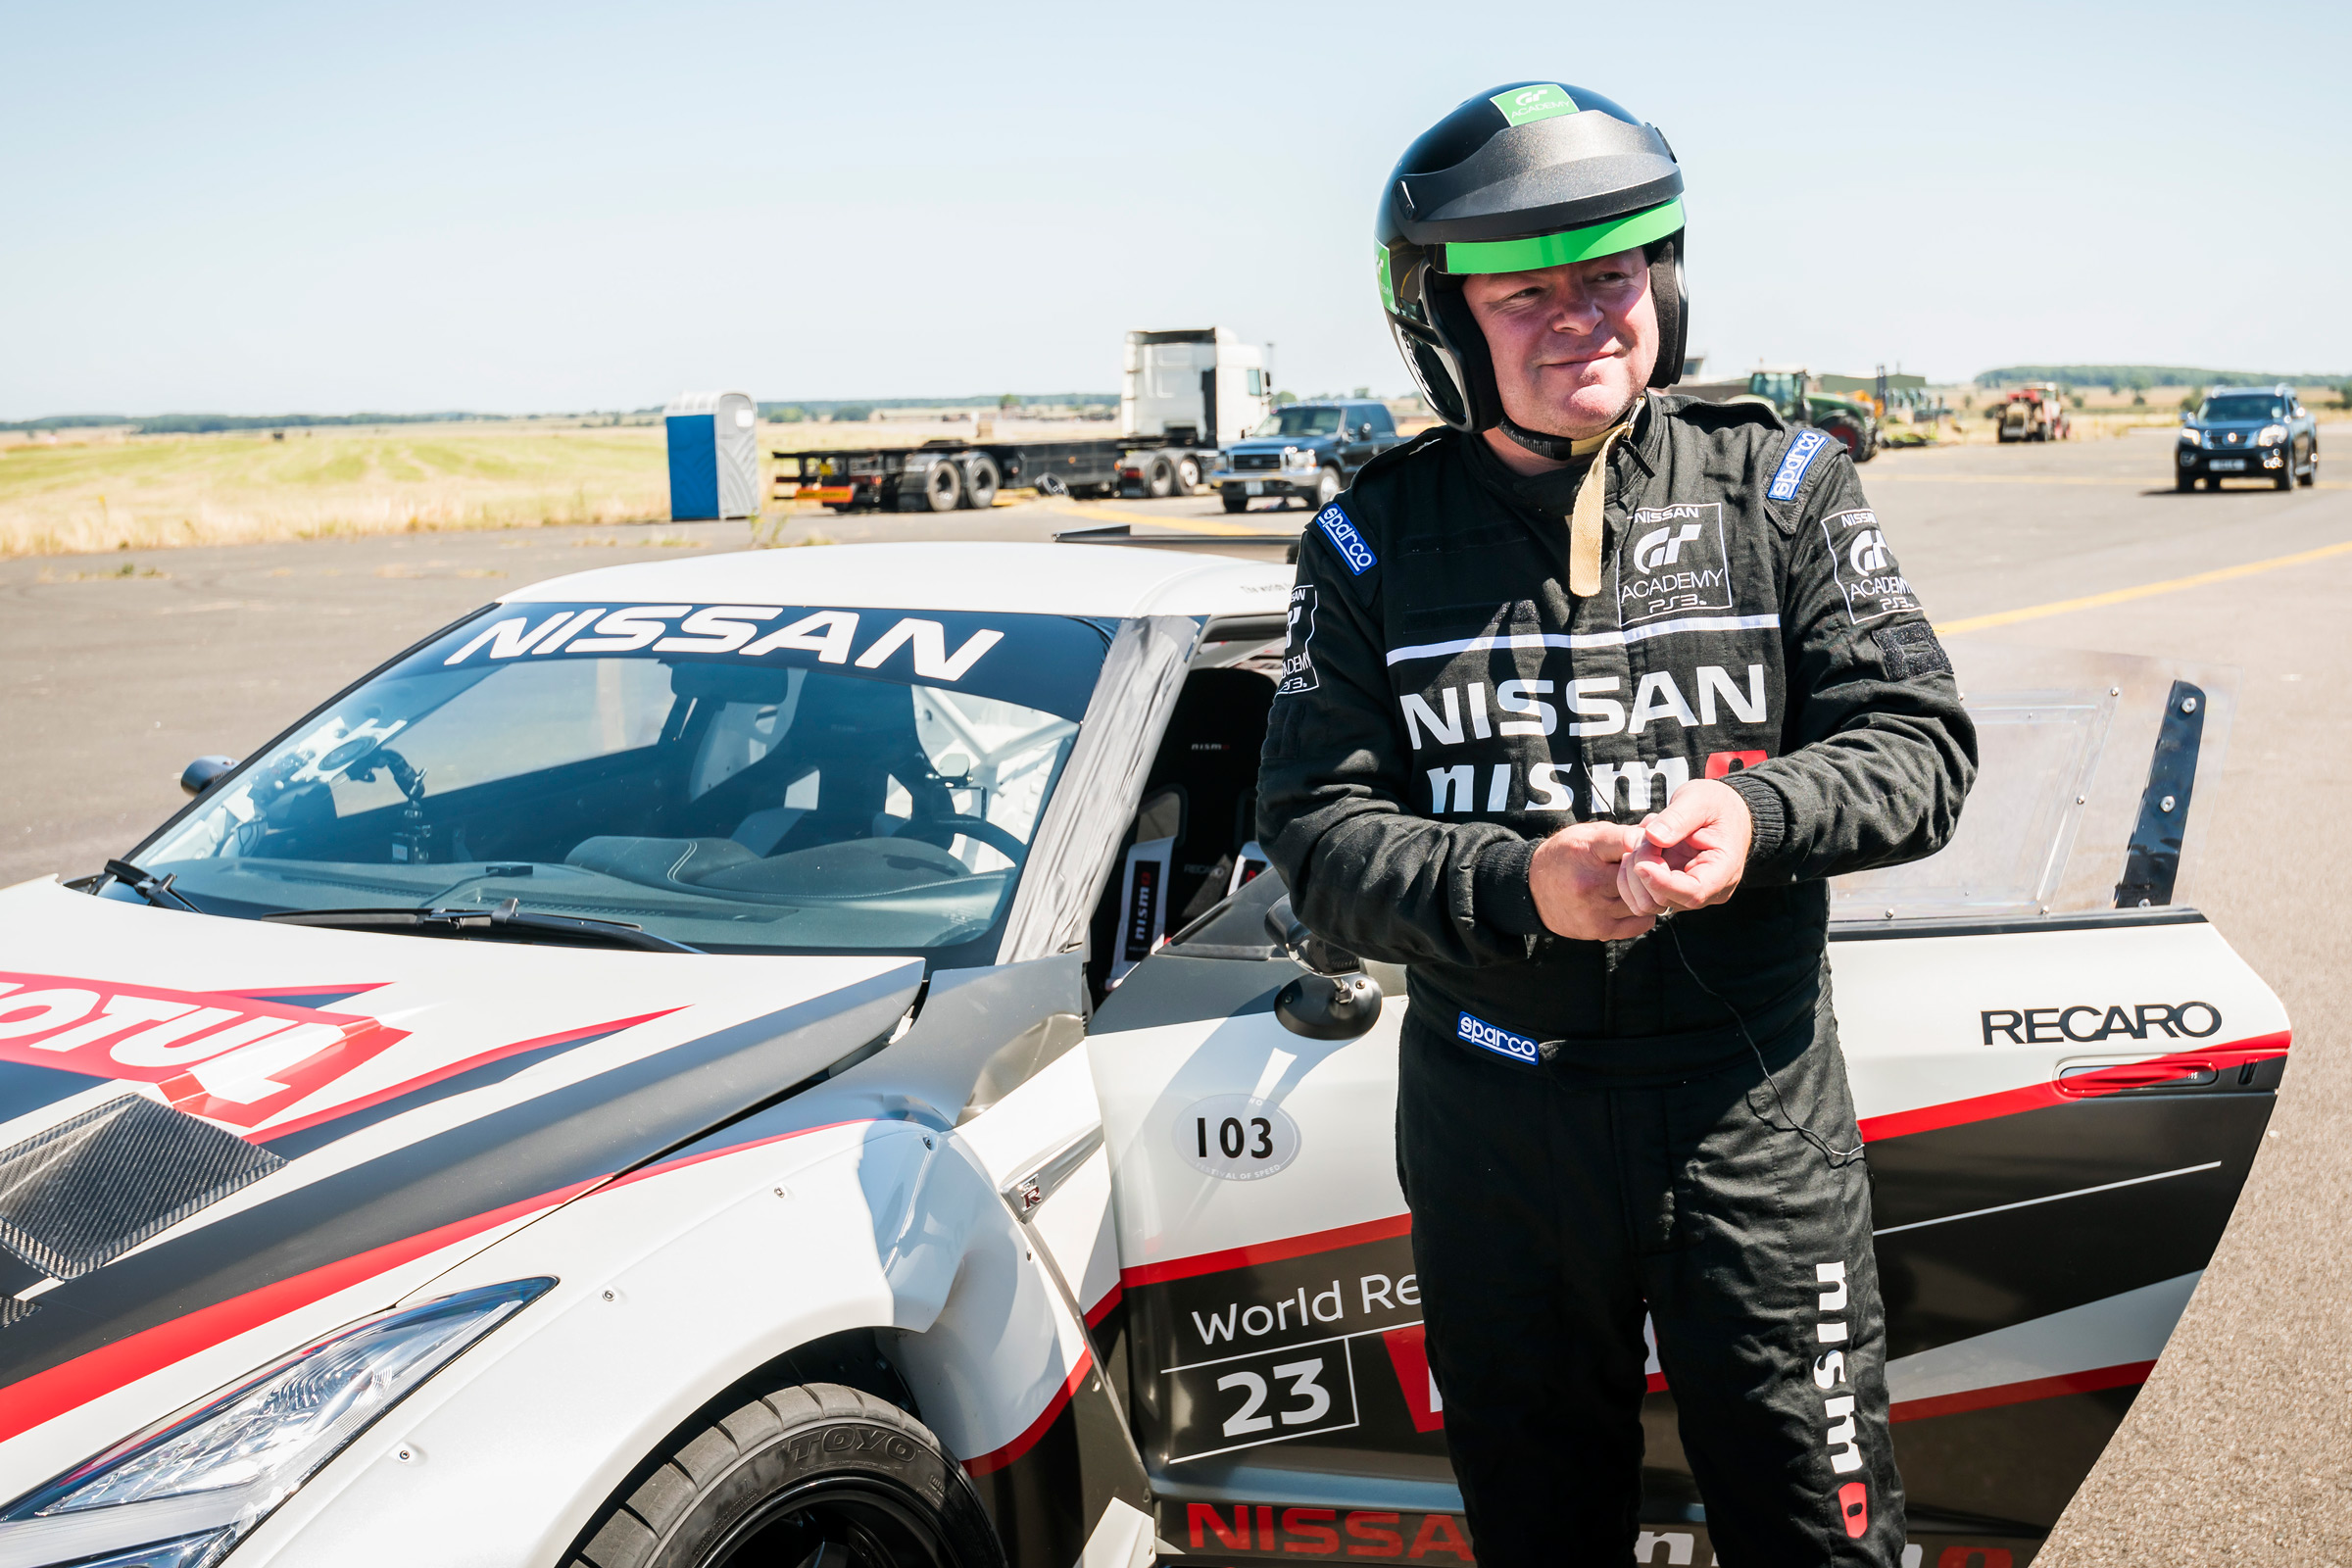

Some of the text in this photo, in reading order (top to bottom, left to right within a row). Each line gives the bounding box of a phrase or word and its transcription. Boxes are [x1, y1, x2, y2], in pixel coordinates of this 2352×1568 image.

[1510, 100, 1570, 119] ACADEMY
[1773, 432, 1820, 496] sparco
[1322, 508, 1372, 567] sparco
[1634, 507, 1699, 523] NISSAN
[1620, 568, 1724, 604] ACADEMY
[443, 605, 1004, 681] NISSAN
[1282, 652, 1311, 678] ADEMY
[1399, 664, 1767, 750] NISSAN
[1135, 871, 1151, 940] nismo
[0, 982, 346, 1104] OTUL
[1460, 1016, 1536, 1056] sparco
[1981, 1002, 2223, 1046] RECARO
[1197, 1117, 1273, 1159] 103
[1196, 1162, 1237, 1180] FESTIVAL
[1254, 1164, 1281, 1178] SPEED
[1192, 1273, 1423, 1346] World Re
[1216, 1358, 1331, 1438] 23
[1813, 1261, 1868, 1539] nismo
[788, 1426, 916, 1462] TOYO
[1187, 1503, 1475, 1561] NISSA
